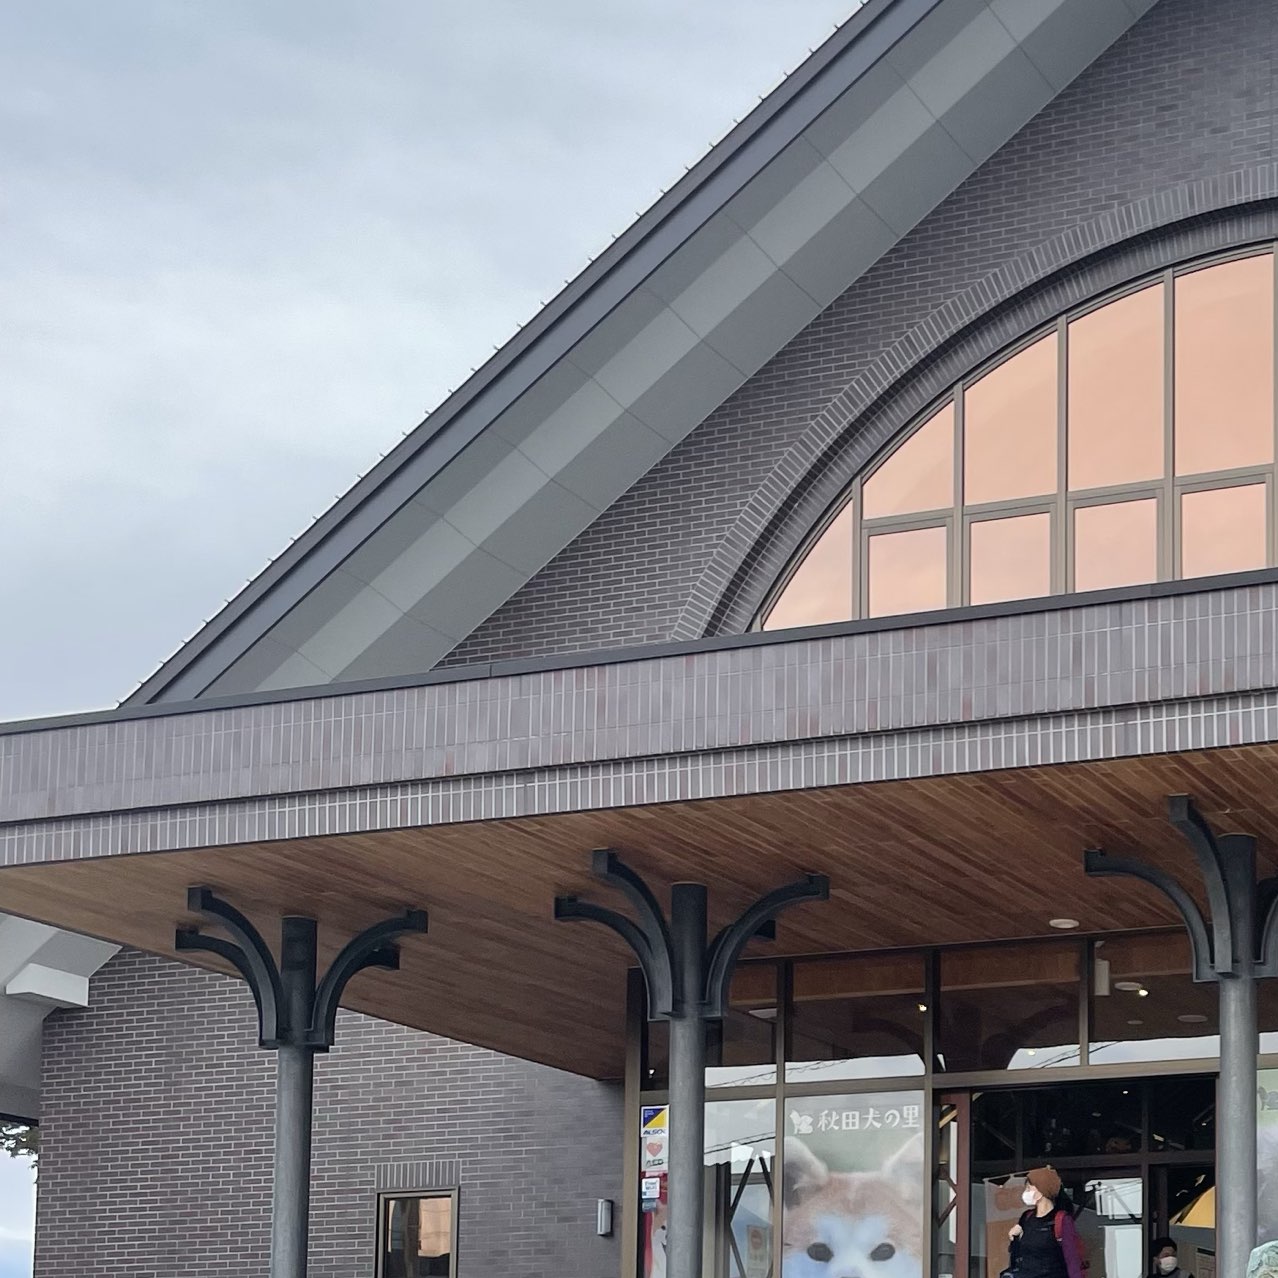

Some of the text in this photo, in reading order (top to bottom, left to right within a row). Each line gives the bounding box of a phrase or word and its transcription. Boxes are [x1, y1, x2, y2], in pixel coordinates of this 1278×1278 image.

[817, 1105, 920, 1132] 秋田犬の里
